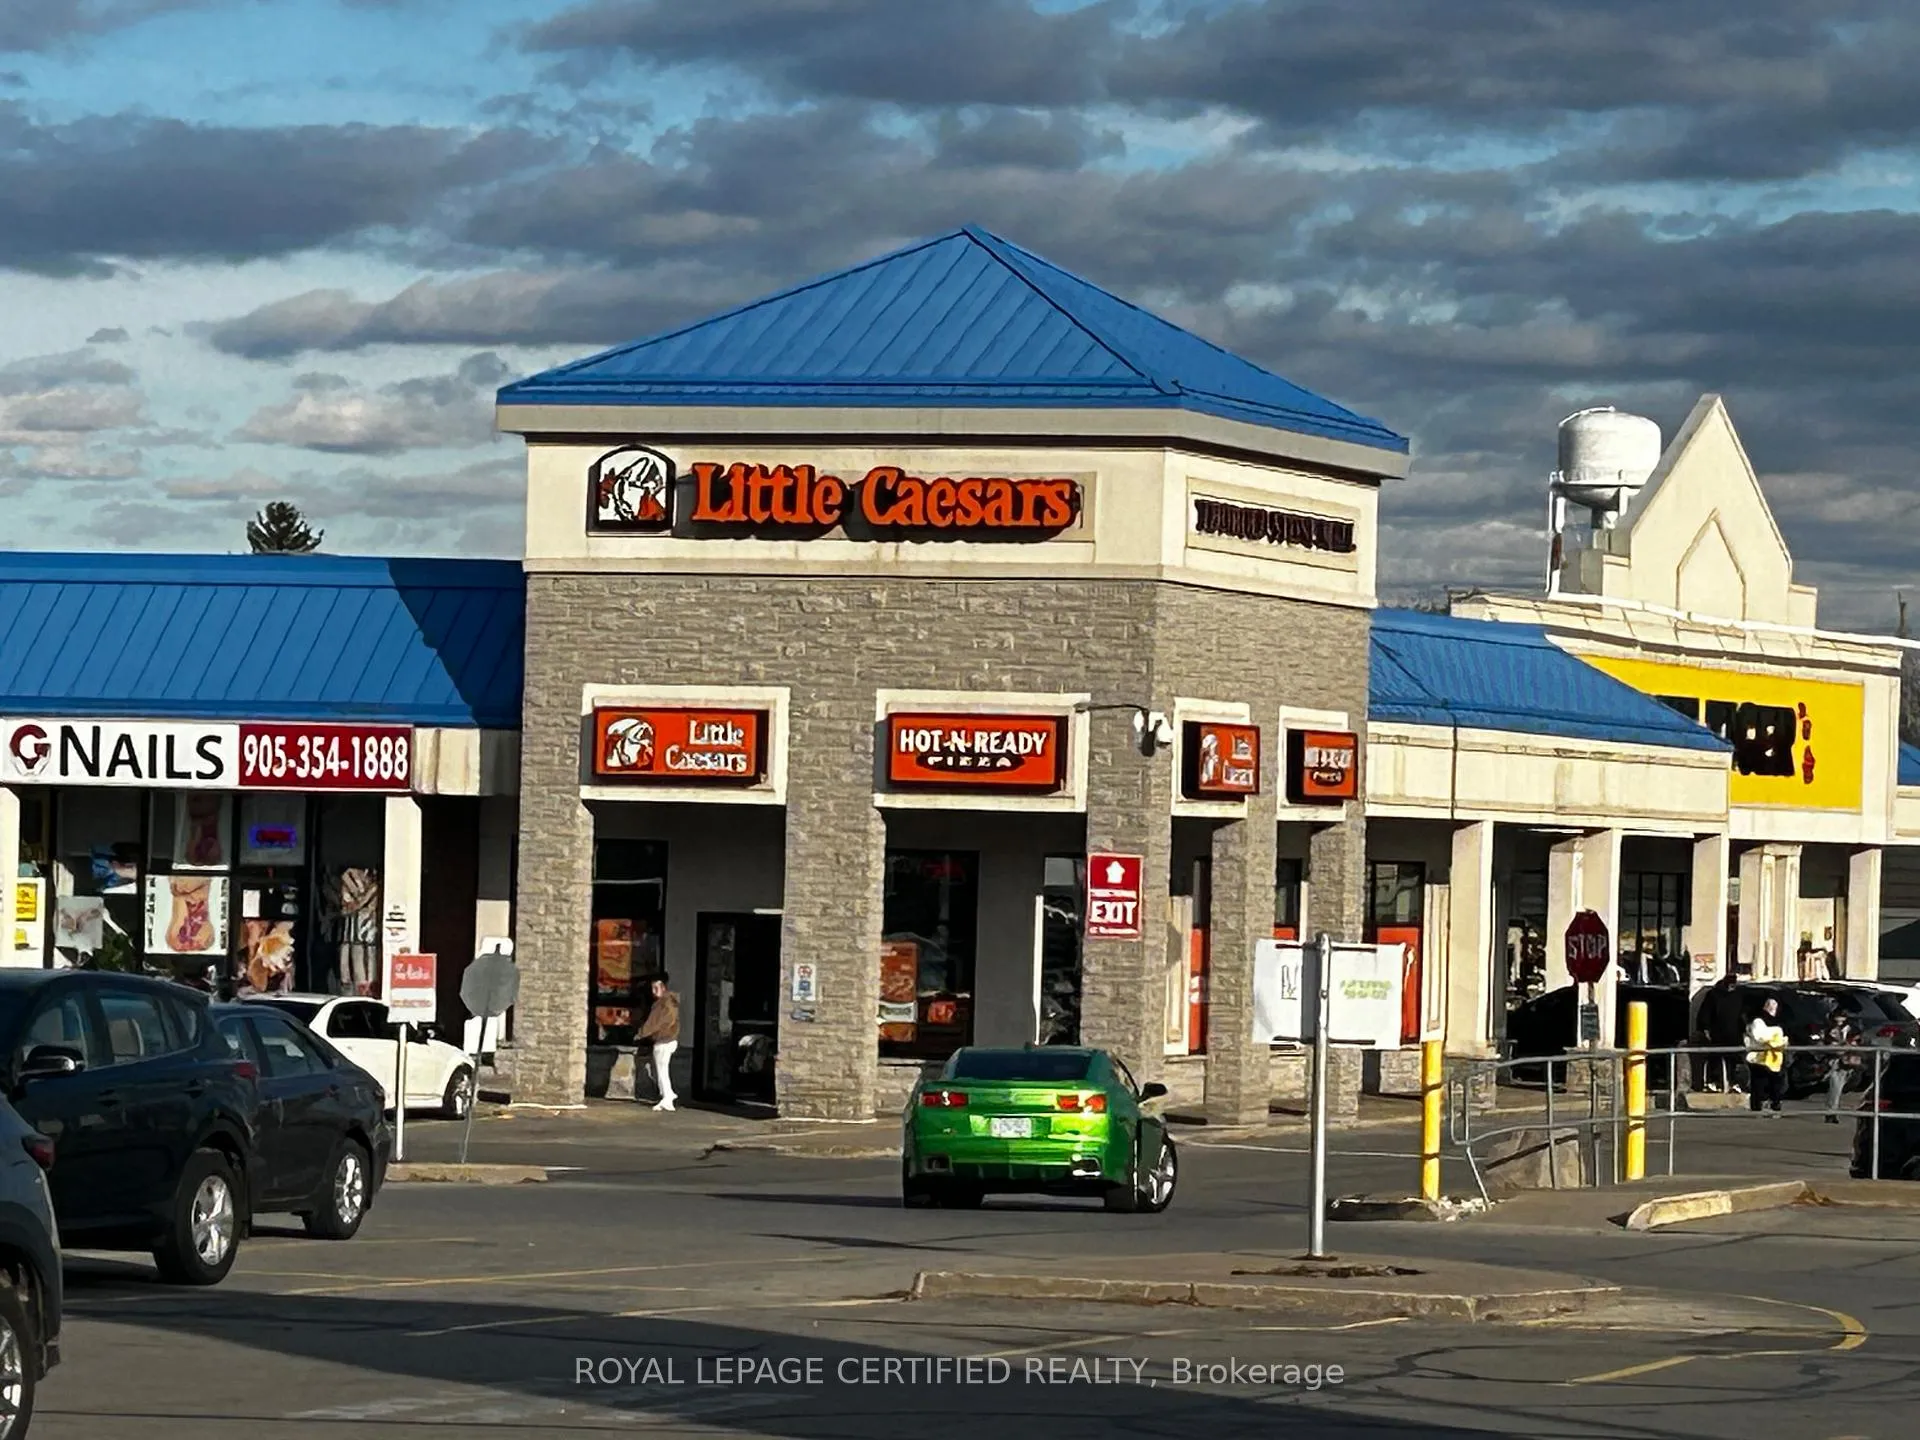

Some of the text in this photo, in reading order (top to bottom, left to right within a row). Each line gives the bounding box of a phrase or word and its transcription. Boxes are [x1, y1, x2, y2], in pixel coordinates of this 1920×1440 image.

[691, 463, 1074, 528] Little Caesars
[689, 720, 744, 746] Little
[900, 729, 1047, 755] HOT-N-READY
[59, 724, 224, 780] NAILS
[243, 733, 410, 779] 905-354-1888
[665, 745, 748, 772] Caesars
[1090, 900, 1138, 925] EXIT
[1568, 934, 1607, 959] STOP
